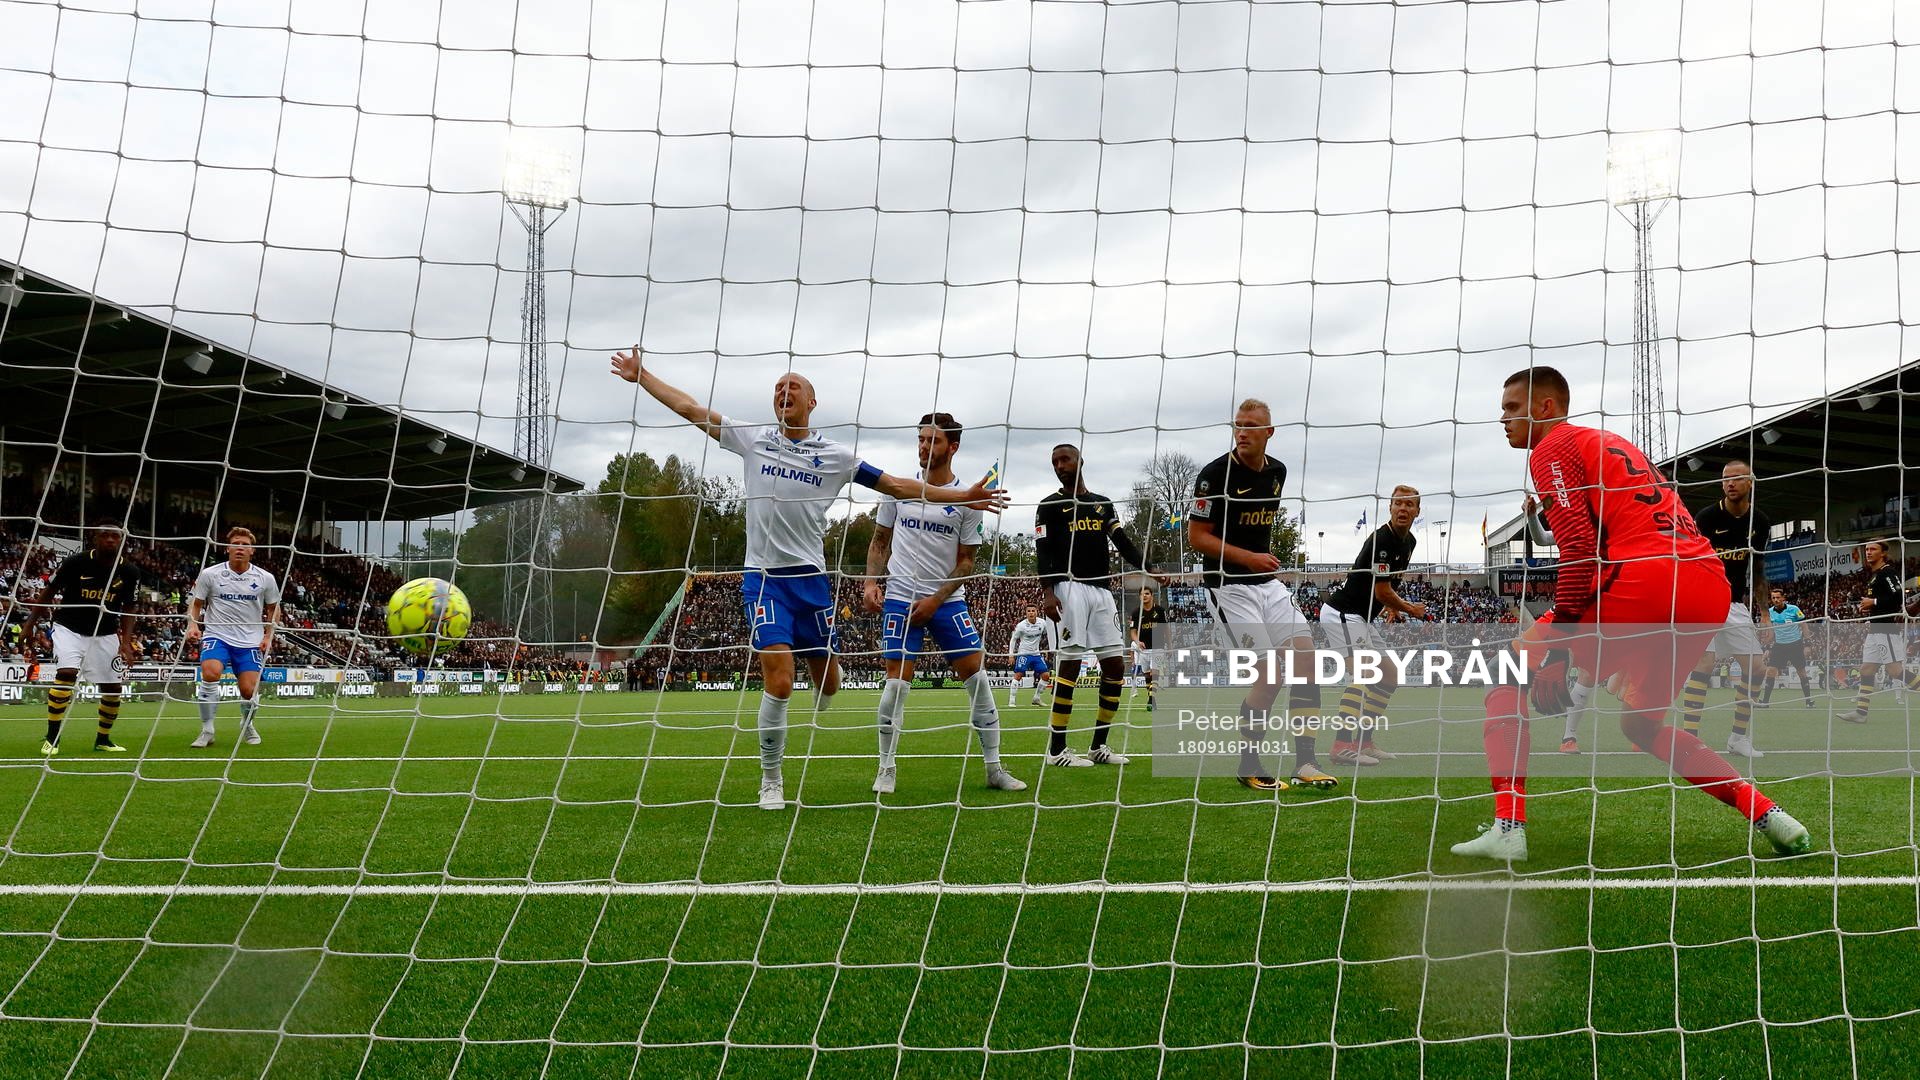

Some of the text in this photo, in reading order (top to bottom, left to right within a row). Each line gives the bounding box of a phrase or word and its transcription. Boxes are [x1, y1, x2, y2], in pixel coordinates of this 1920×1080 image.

[761, 464, 823, 487] HOLMEN
[900, 518, 954, 534] HOLMEN
[1068, 516, 1104, 532] notar
[1794, 554, 1824, 572] Svenska
[81, 588, 116, 602] notar
[267, 672, 284, 680] ATEA
[304, 672, 325, 683] Fiskeby
[277, 684, 314, 696] HOLMEN
[342, 684, 375, 695] HOLMEN
[411, 684, 440, 694] HOLMEN
[459, 684, 482, 693] HOLMEN
[696, 682, 734, 690] HOLMEN
[840, 681, 880, 689] HOLMEN
